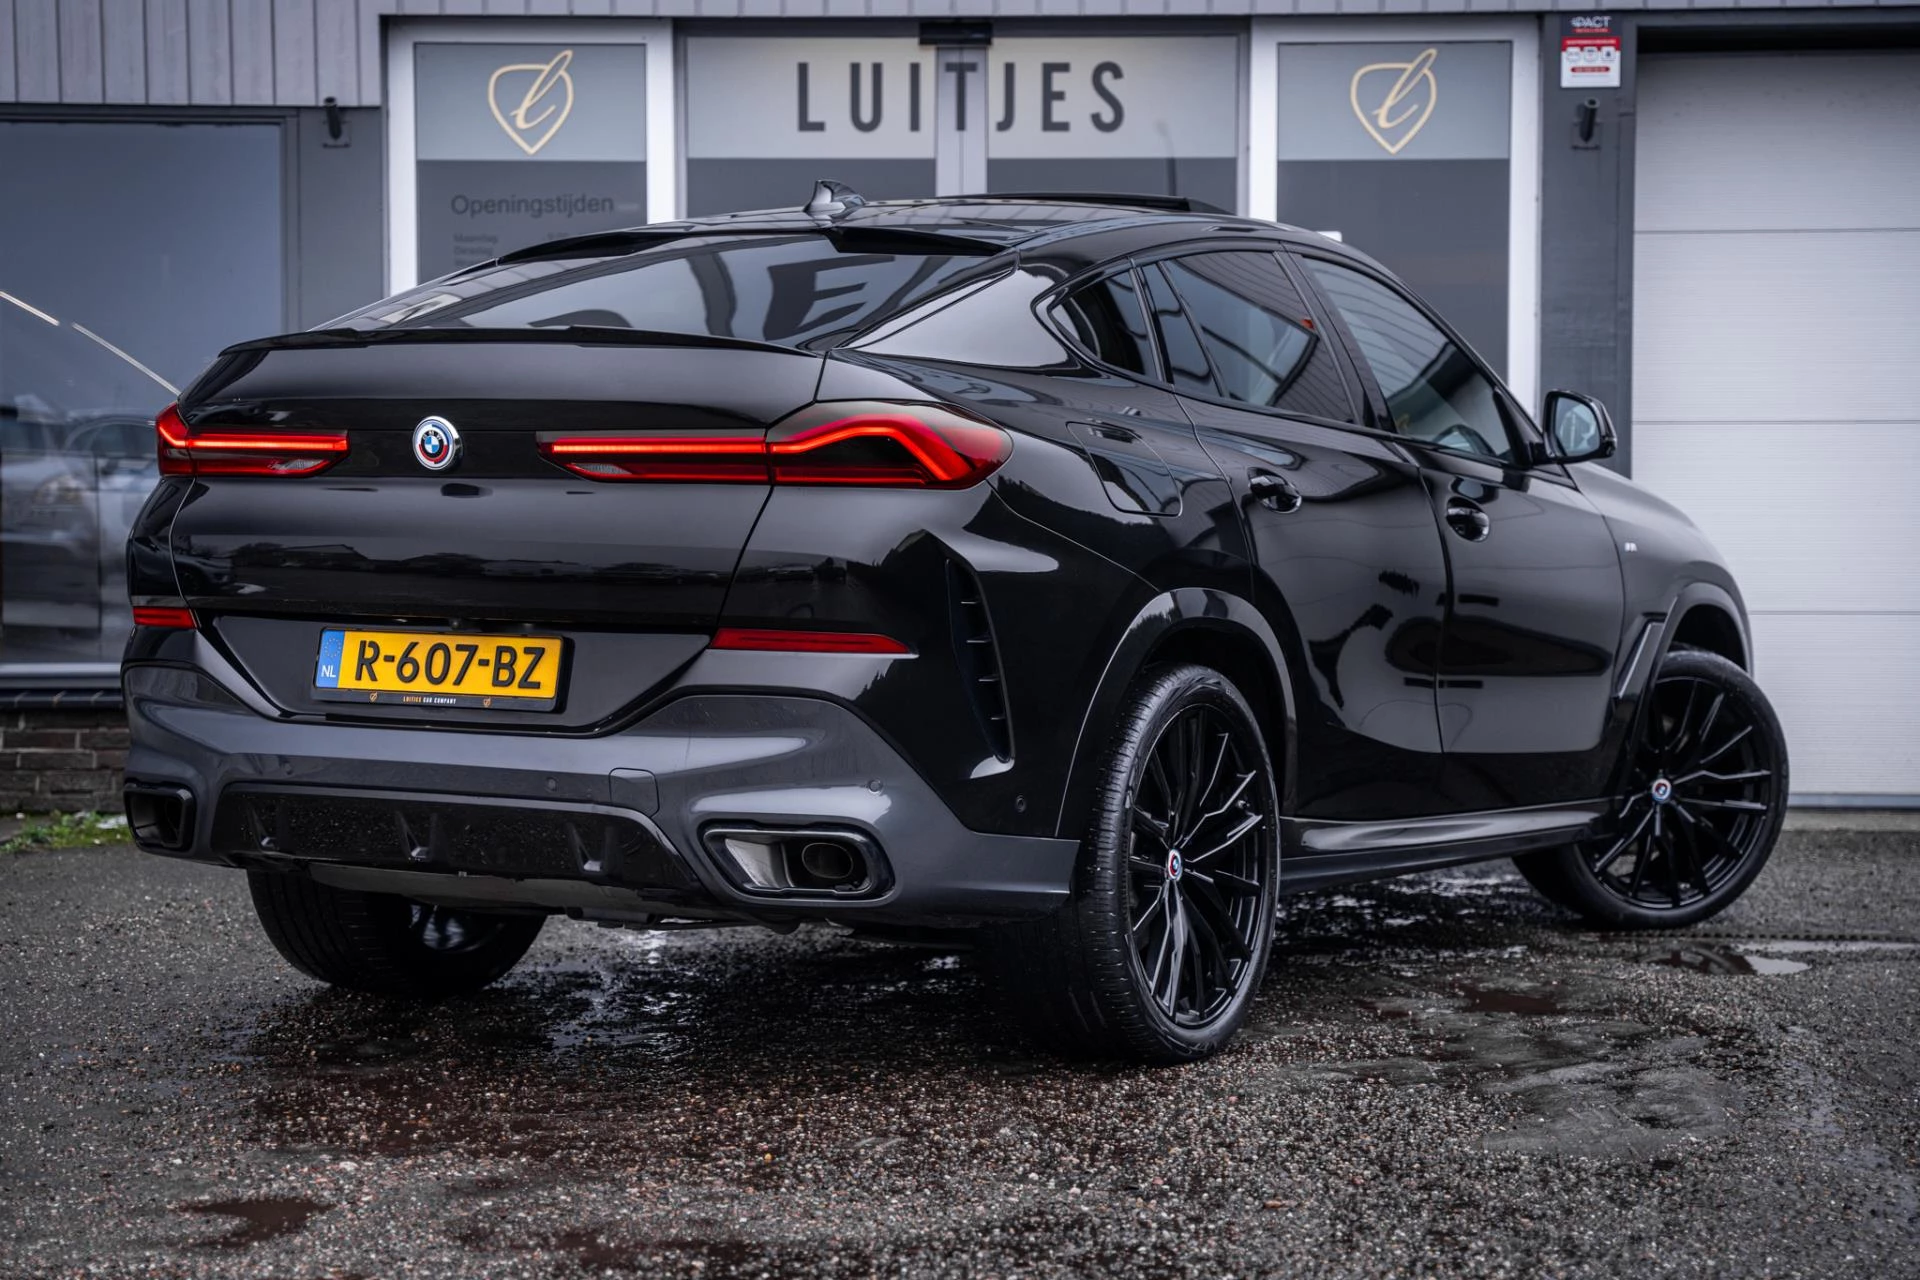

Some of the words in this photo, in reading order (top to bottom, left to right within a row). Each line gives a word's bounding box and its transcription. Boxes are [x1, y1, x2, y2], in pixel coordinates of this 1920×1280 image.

[797, 61, 1124, 133] LUITJES
[451, 194, 614, 219] Openingstijden
[321, 665, 336, 678] NL
[355, 640, 546, 689] R-607-BZ
